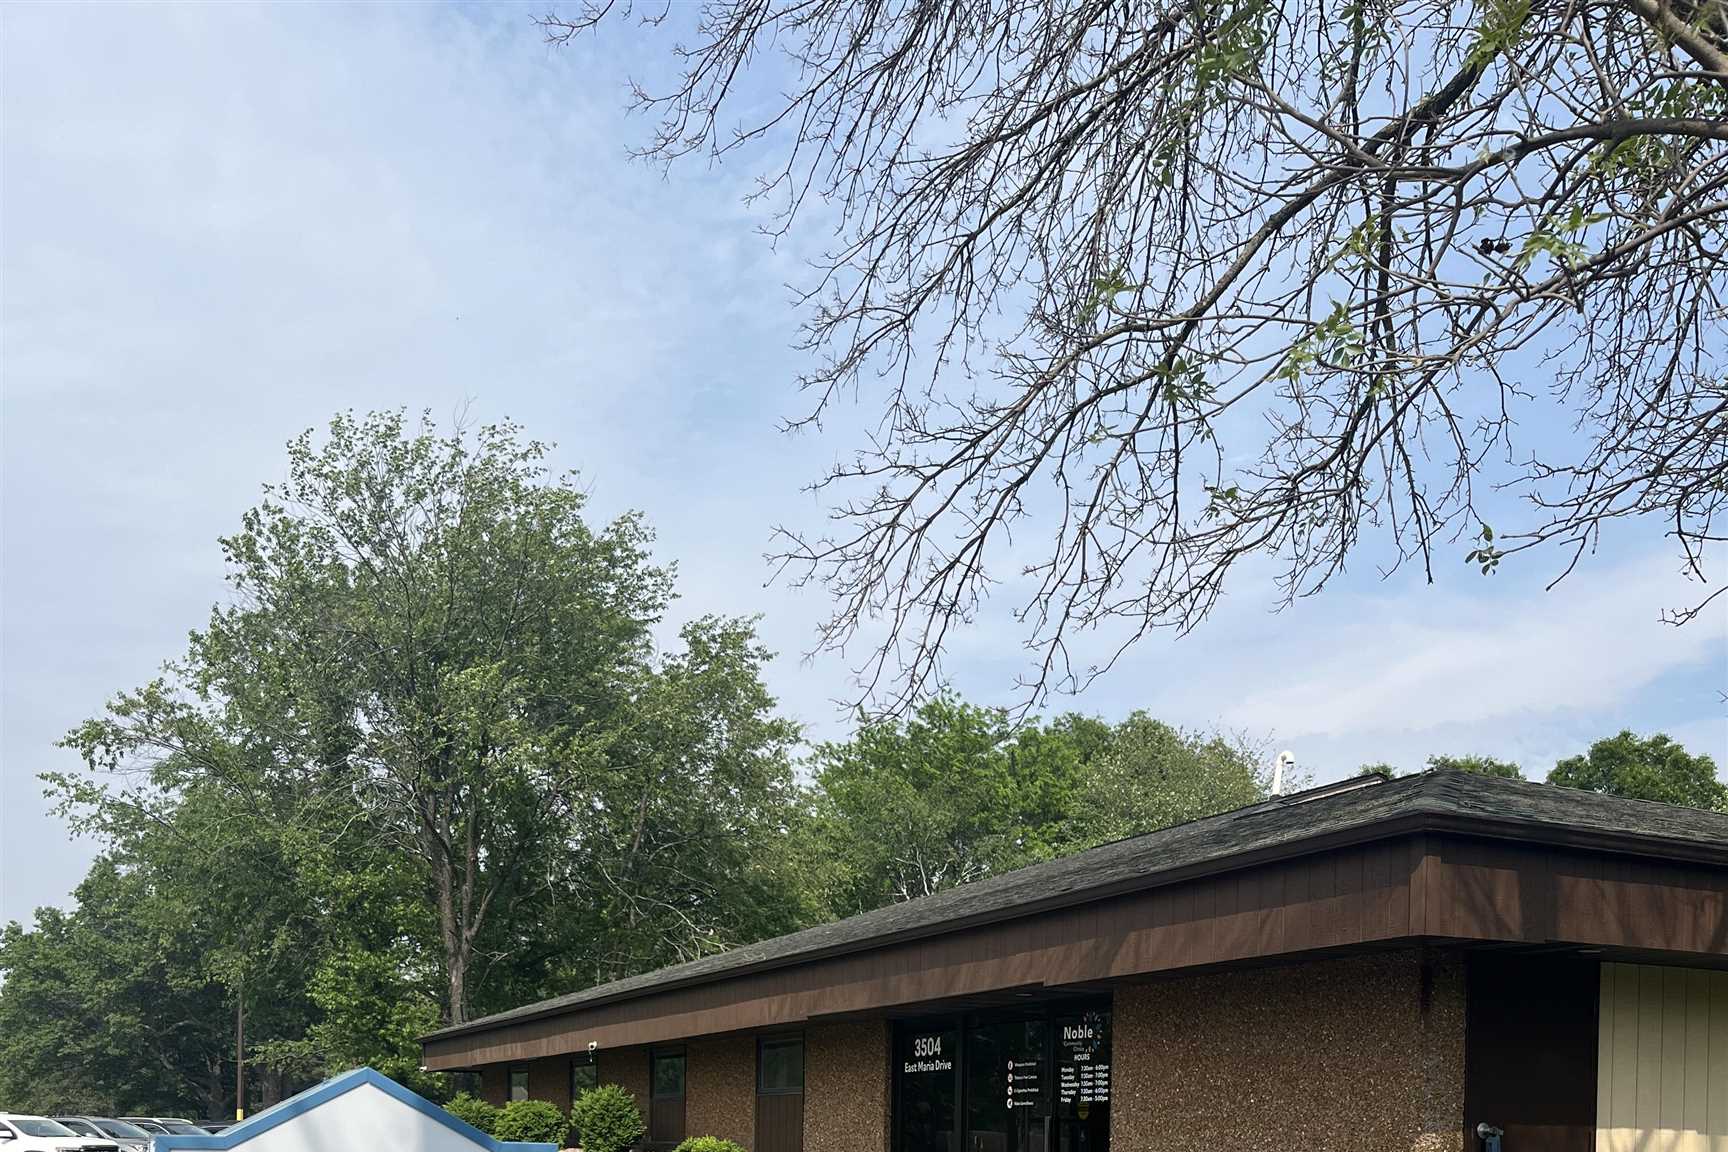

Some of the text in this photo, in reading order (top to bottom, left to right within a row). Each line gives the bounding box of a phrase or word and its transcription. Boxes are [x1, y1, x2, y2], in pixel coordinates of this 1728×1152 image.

[1063, 1024, 1093, 1040] Noble
[914, 1036, 941, 1057] 3504
[904, 1059, 952, 1073] East Maria Drive
